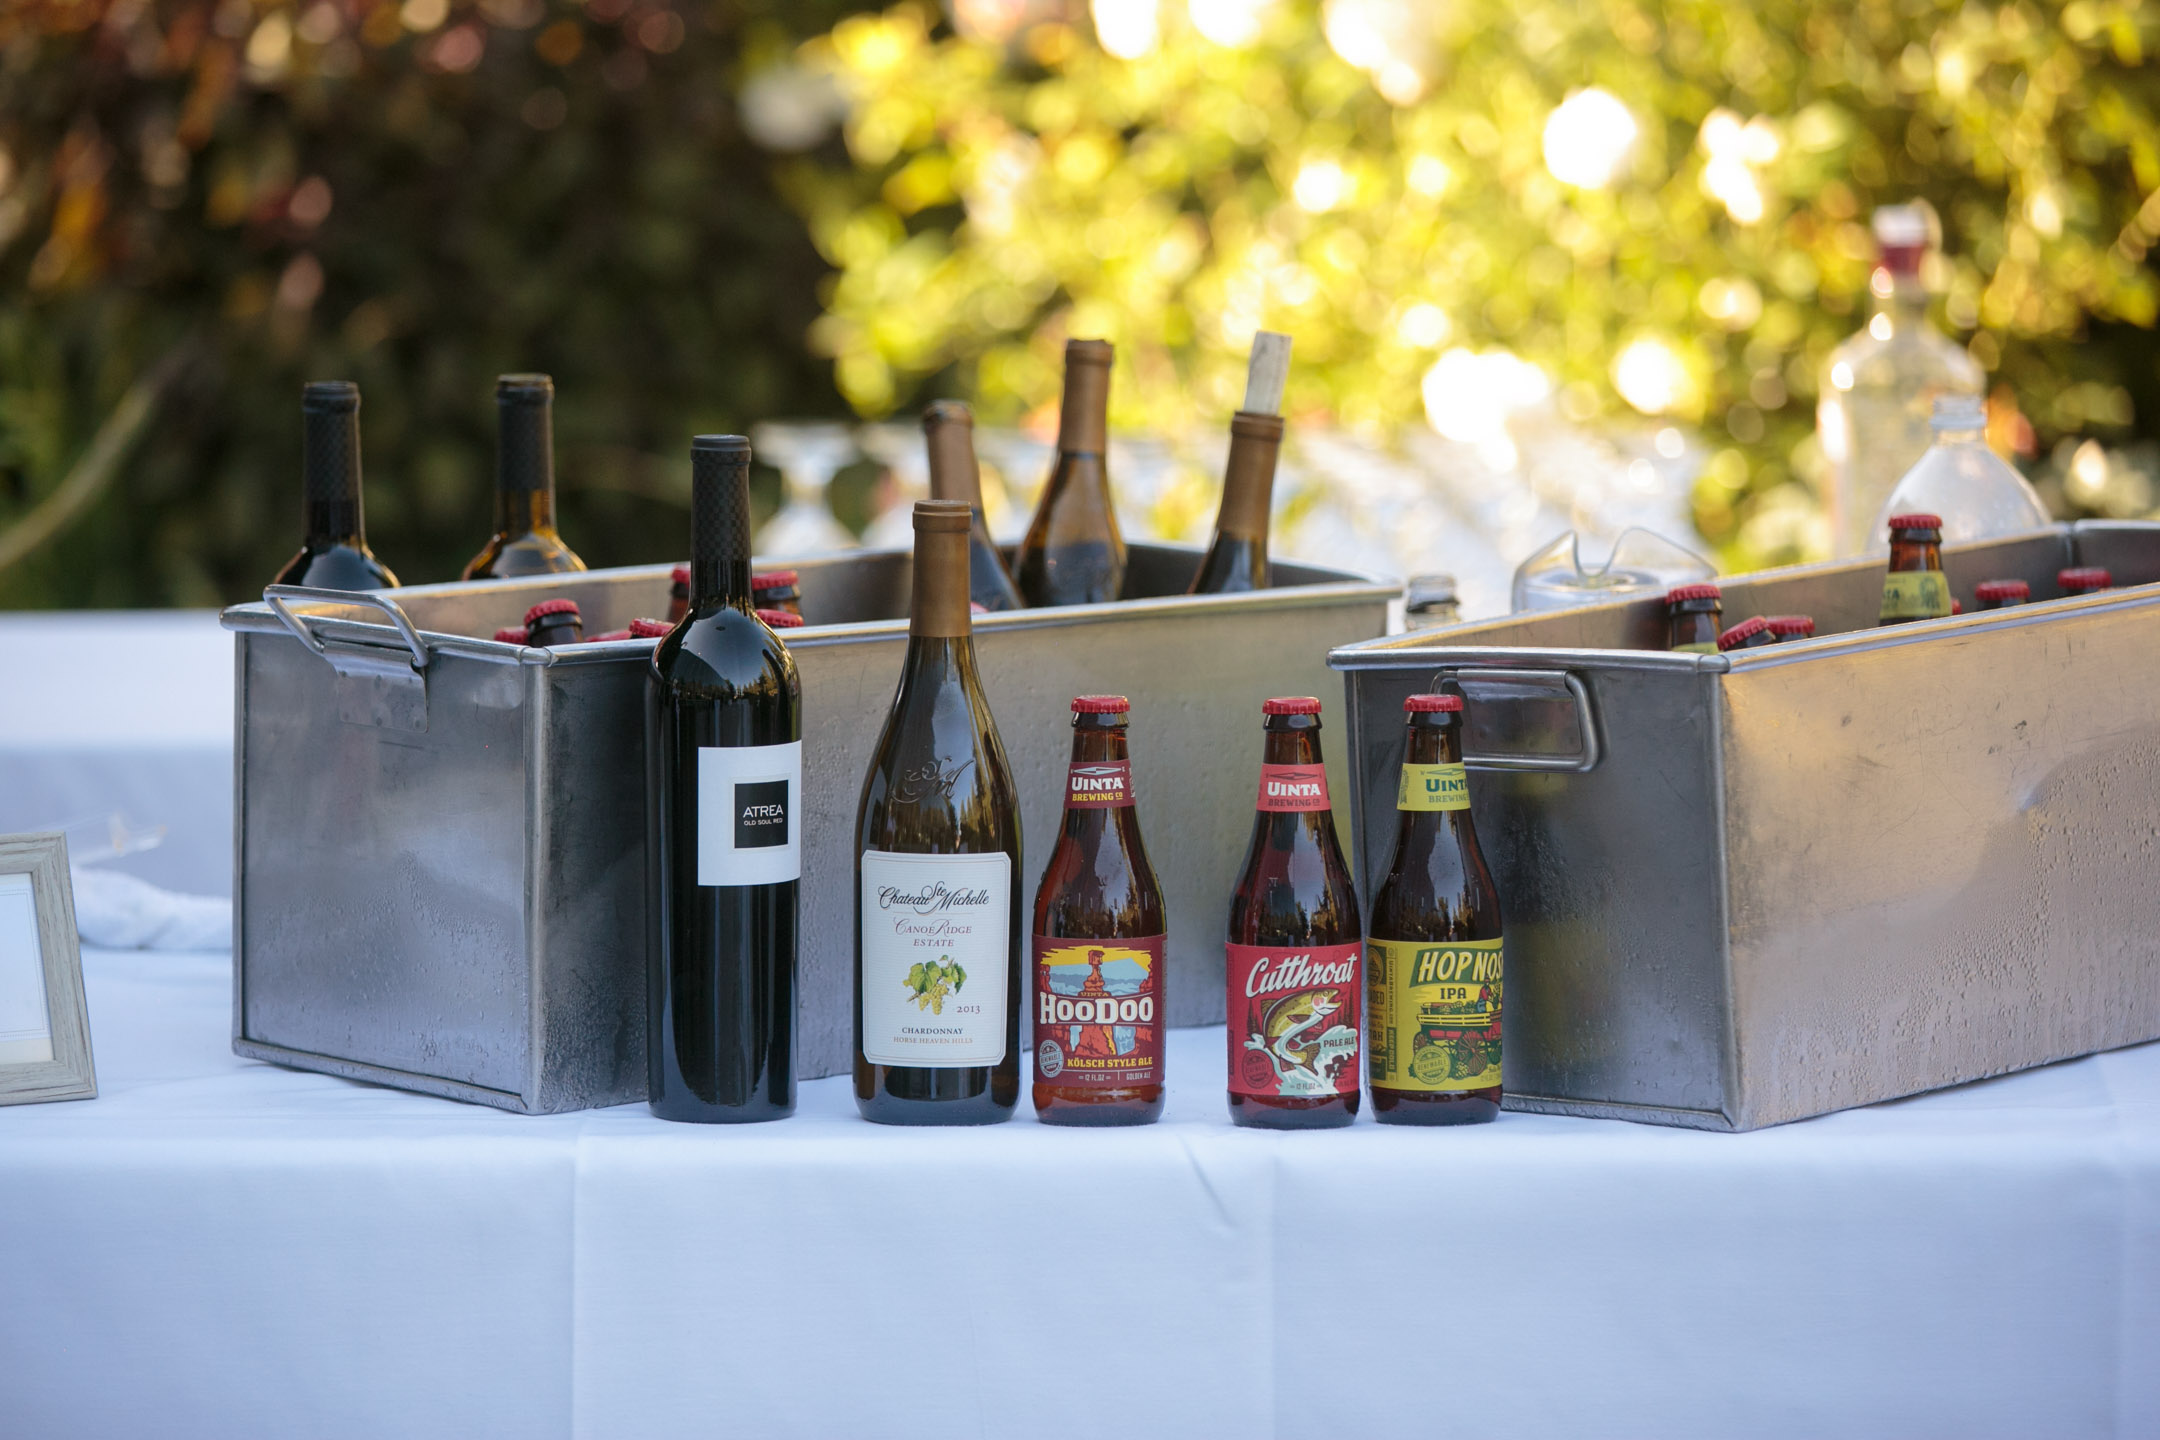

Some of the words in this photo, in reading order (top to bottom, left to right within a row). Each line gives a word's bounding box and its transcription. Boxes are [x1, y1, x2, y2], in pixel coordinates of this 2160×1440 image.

[1072, 777, 1124, 791] UINTA
[1267, 782, 1322, 796] UINTA
[1072, 792, 1114, 802] BREWING
[1268, 799, 1311, 807] BREWING
[743, 804, 784, 818] ATREA
[921, 881, 947, 899] Ste
[878, 886, 930, 909] Chateau
[933, 888, 989, 912] Michelle
[913, 938, 954, 948] ESTATE
[1418, 951, 1473, 983] HOP
[1245, 953, 1358, 998] Cutthroat
[1440, 987, 1467, 1000] IPA
[956, 1005, 981, 1014] 2013
[902, 1027, 964, 1035] CHARDONNAY
[893, 1036, 917, 1044] HORSE
[1324, 1038, 1344, 1048] PALE
[1344, 1036, 1355, 1046] ALE
[1067, 1057, 1105, 1068] KÖLSCH
[1107, 1058, 1137, 1068] STYLE
[1138, 1056, 1153, 1066] ALE
